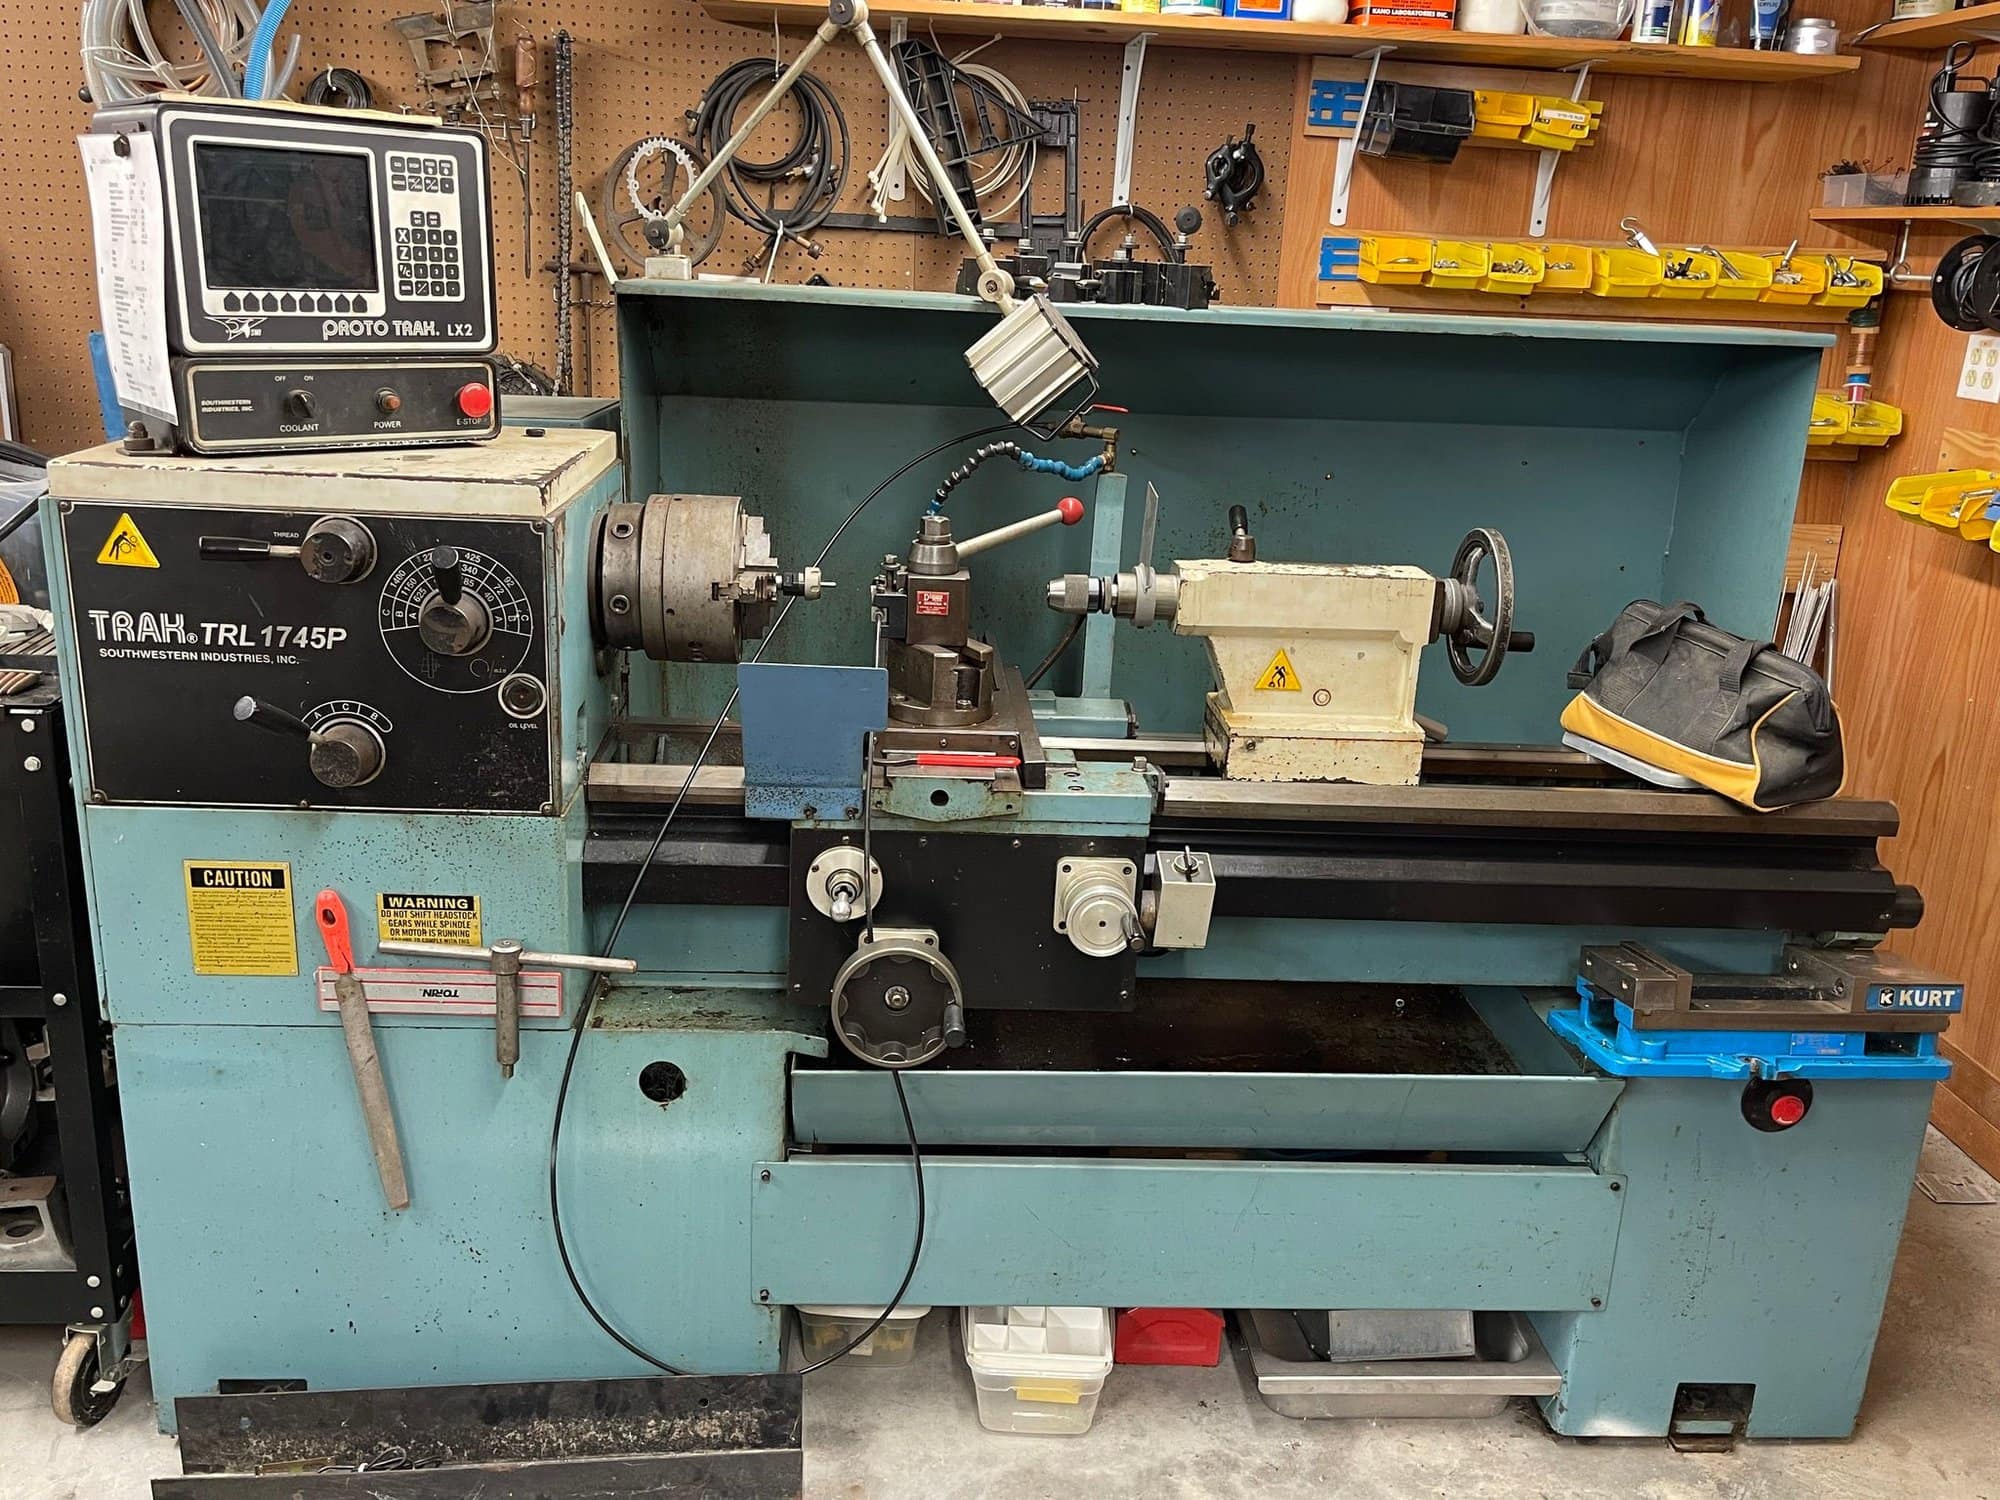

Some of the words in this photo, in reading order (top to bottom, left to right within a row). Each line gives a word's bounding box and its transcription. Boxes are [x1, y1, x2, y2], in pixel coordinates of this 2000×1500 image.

[398, 229, 409, 242] X
[399, 246, 410, 260] Z
[322, 319, 389, 341] PROTO
[447, 323, 473, 337] LX2
[373, 420, 401, 429] POWER
[456, 418, 482, 426] E-STOP
[279, 423, 319, 433] COOLANT
[464, 552, 481, 563] 425
[461, 563, 478, 575] 340
[389, 569, 407, 588] 1400
[413, 587, 427, 602] 625
[494, 583, 505, 595] 72
[484, 592, 495, 602] 40
[382, 608, 391, 616] C
[200, 622, 256, 647] TRL
[260, 625, 348, 649] 1745P
[99, 648, 198, 660] SOUTHWESTERN
[200, 652, 274, 664] INDUSTRIES,
[276, 655, 300, 665] INC.
[342, 703, 350, 711] C
[314, 711, 322, 719] A
[370, 712, 379, 720] B
[203, 869, 272, 887] CAUTION
[388, 897, 469, 909] WARNING
[381, 909, 391, 918] DO
[393, 910, 409, 918] NOT
[410, 910, 432, 919] SHIFT
[433, 911, 478, 920] HEADSTOCK
[388, 919, 412, 928] GEARS
[414, 920, 437, 928] WHILE
[439, 920, 471, 929] SPINDLE
[390, 928, 400, 936] OR
[401, 928, 427, 937] MOTOR
[437, 930, 470, 938] RUNNING
[1899, 989, 1956, 1007] KURT
